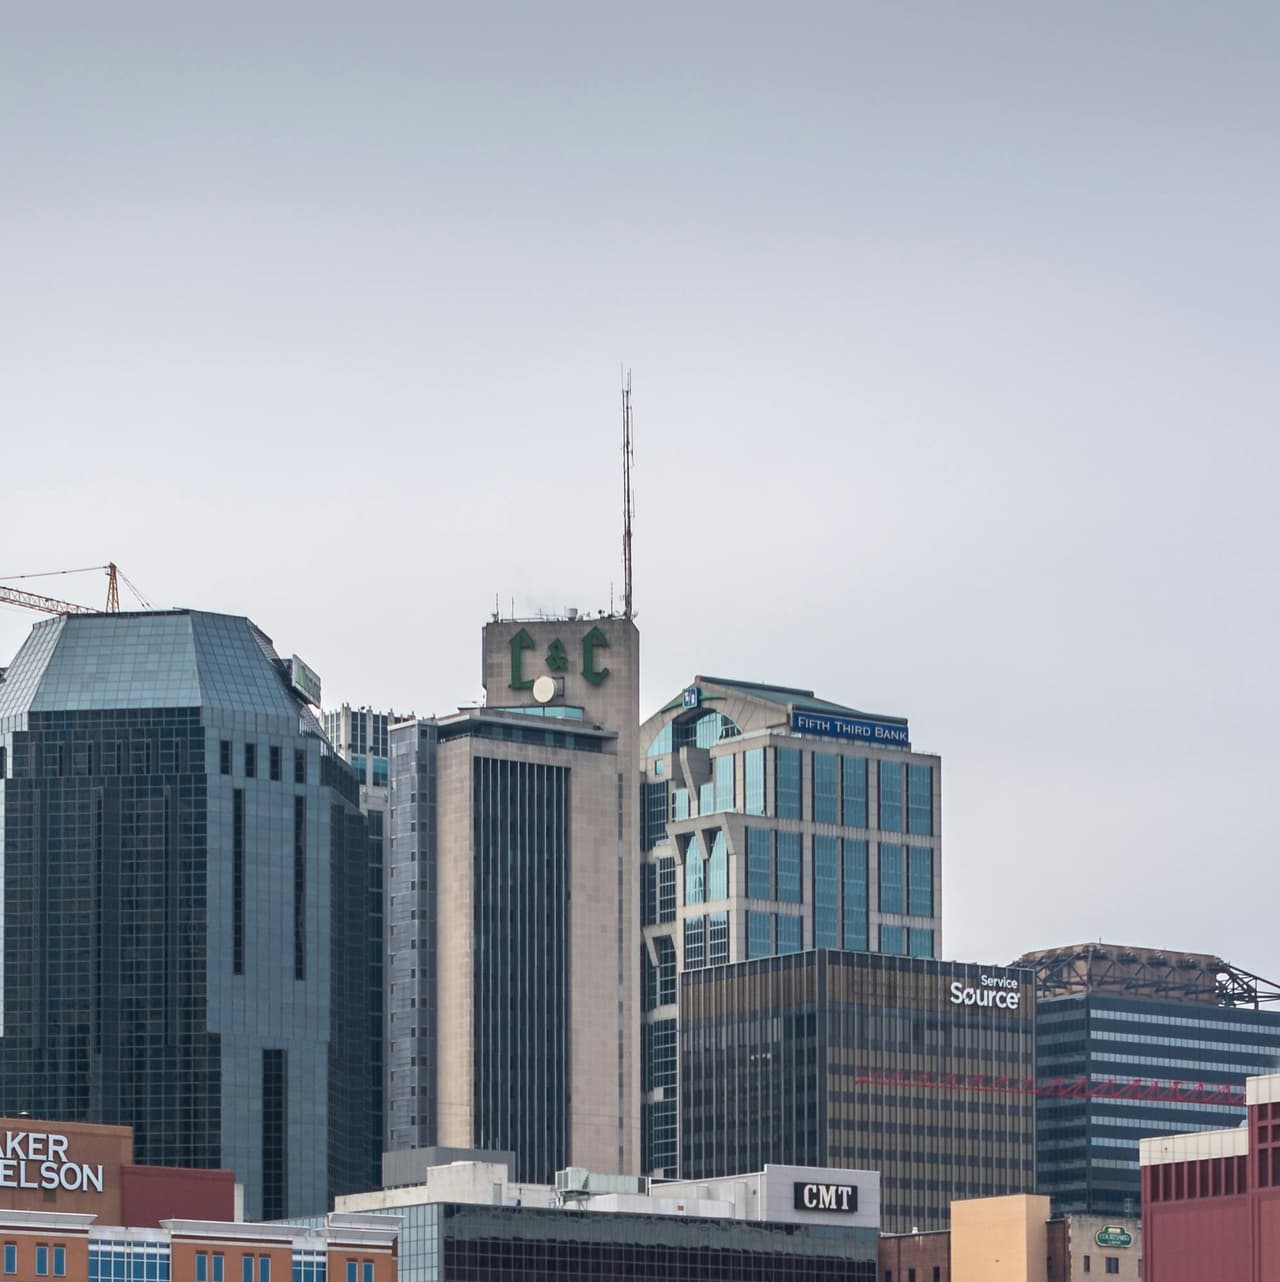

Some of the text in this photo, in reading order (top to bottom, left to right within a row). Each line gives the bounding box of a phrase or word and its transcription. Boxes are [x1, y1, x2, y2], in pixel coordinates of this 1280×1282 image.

[798, 717, 907, 742] FIFTH THIRD BANK
[981, 974, 1018, 988] Service
[950, 982, 1020, 1009] Source
[803, 1184, 852, 1210] CMT
